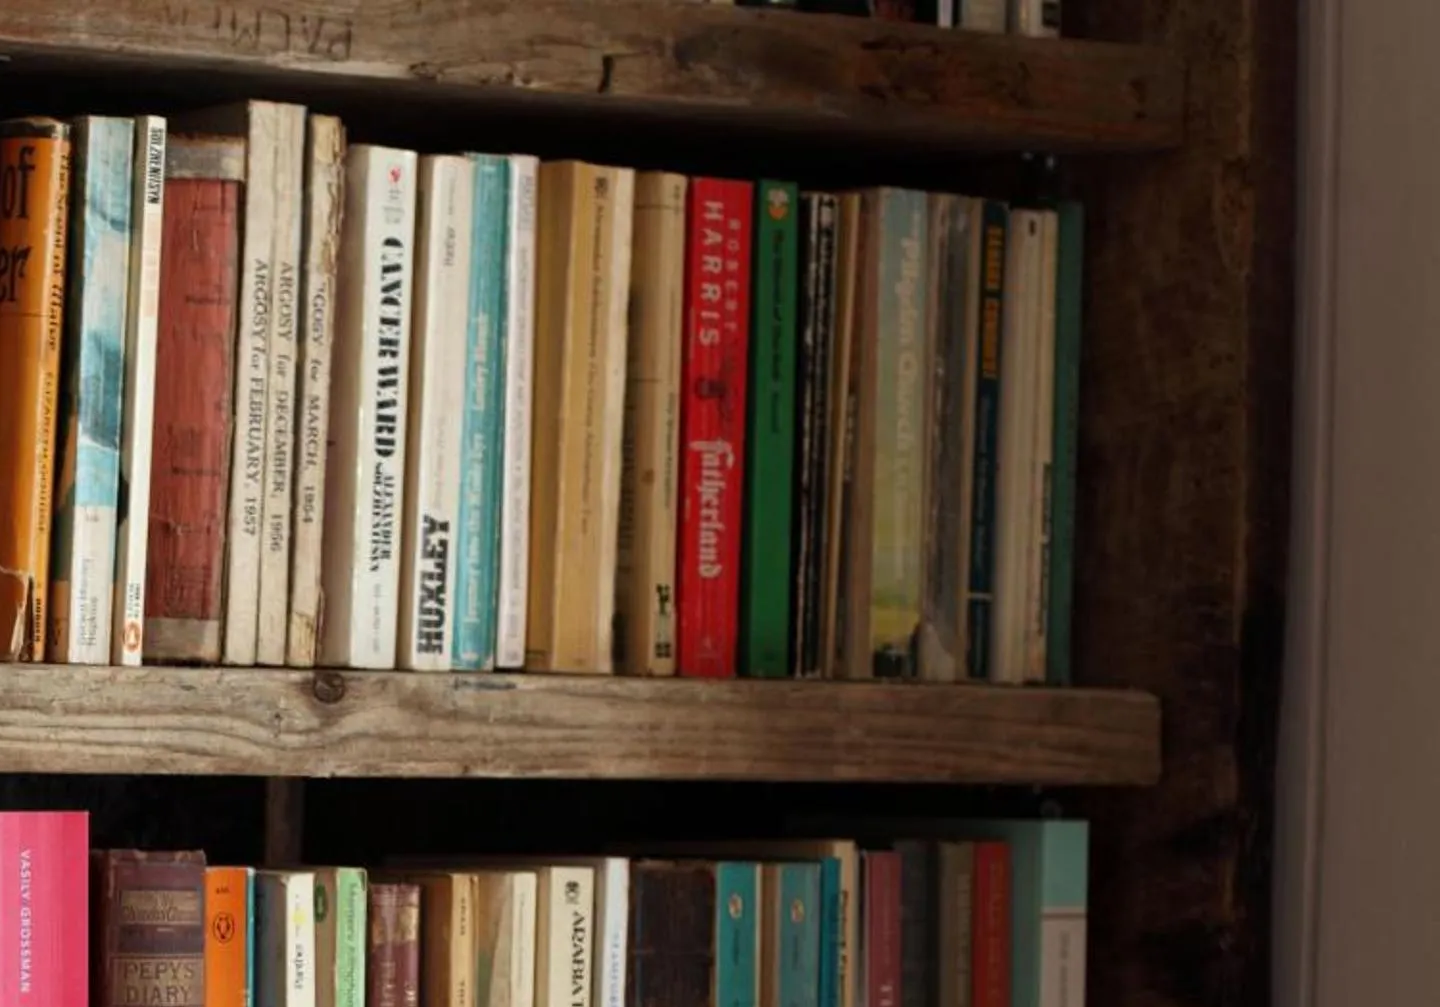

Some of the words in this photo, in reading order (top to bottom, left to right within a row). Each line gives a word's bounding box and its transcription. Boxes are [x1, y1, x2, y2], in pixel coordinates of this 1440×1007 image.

[0, 145, 37, 221] of
[148, 127, 163, 204] SOLZHENITSYN
[250, 259, 268, 342] ARGOSY
[276, 261, 294, 342] ARGOSY
[311, 281, 327, 346] GOSY
[378, 237, 405, 358] CANCER
[700, 202, 725, 347] HARRIS
[725, 219, 743, 334] ROBERT
[250, 346, 266, 371] for
[274, 354, 291, 378] for
[310, 359, 323, 381] for
[244, 378, 264, 488] FEBRUARY,
[271, 390, 289, 499] DECEMBER,
[303, 394, 321, 471] MARCH,
[373, 361, 400, 459] WARD
[242, 497, 257, 538] 1957
[269, 513, 284, 553] 1956
[302, 485, 316, 525] 1954
[368, 462, 386, 573] SOLZHENITSYN
[379, 475, 396, 562] ALEXANDER
[687, 440, 736, 579] Fatherland
[416, 513, 450, 656] HUXLEY
[20, 849, 32, 900] VASILY
[20, 907, 32, 993] GROSSMAN
[124, 961, 196, 982] PEPYS
[570, 911, 586, 996] ARABIA
[126, 984, 192, 1005] DIARY
